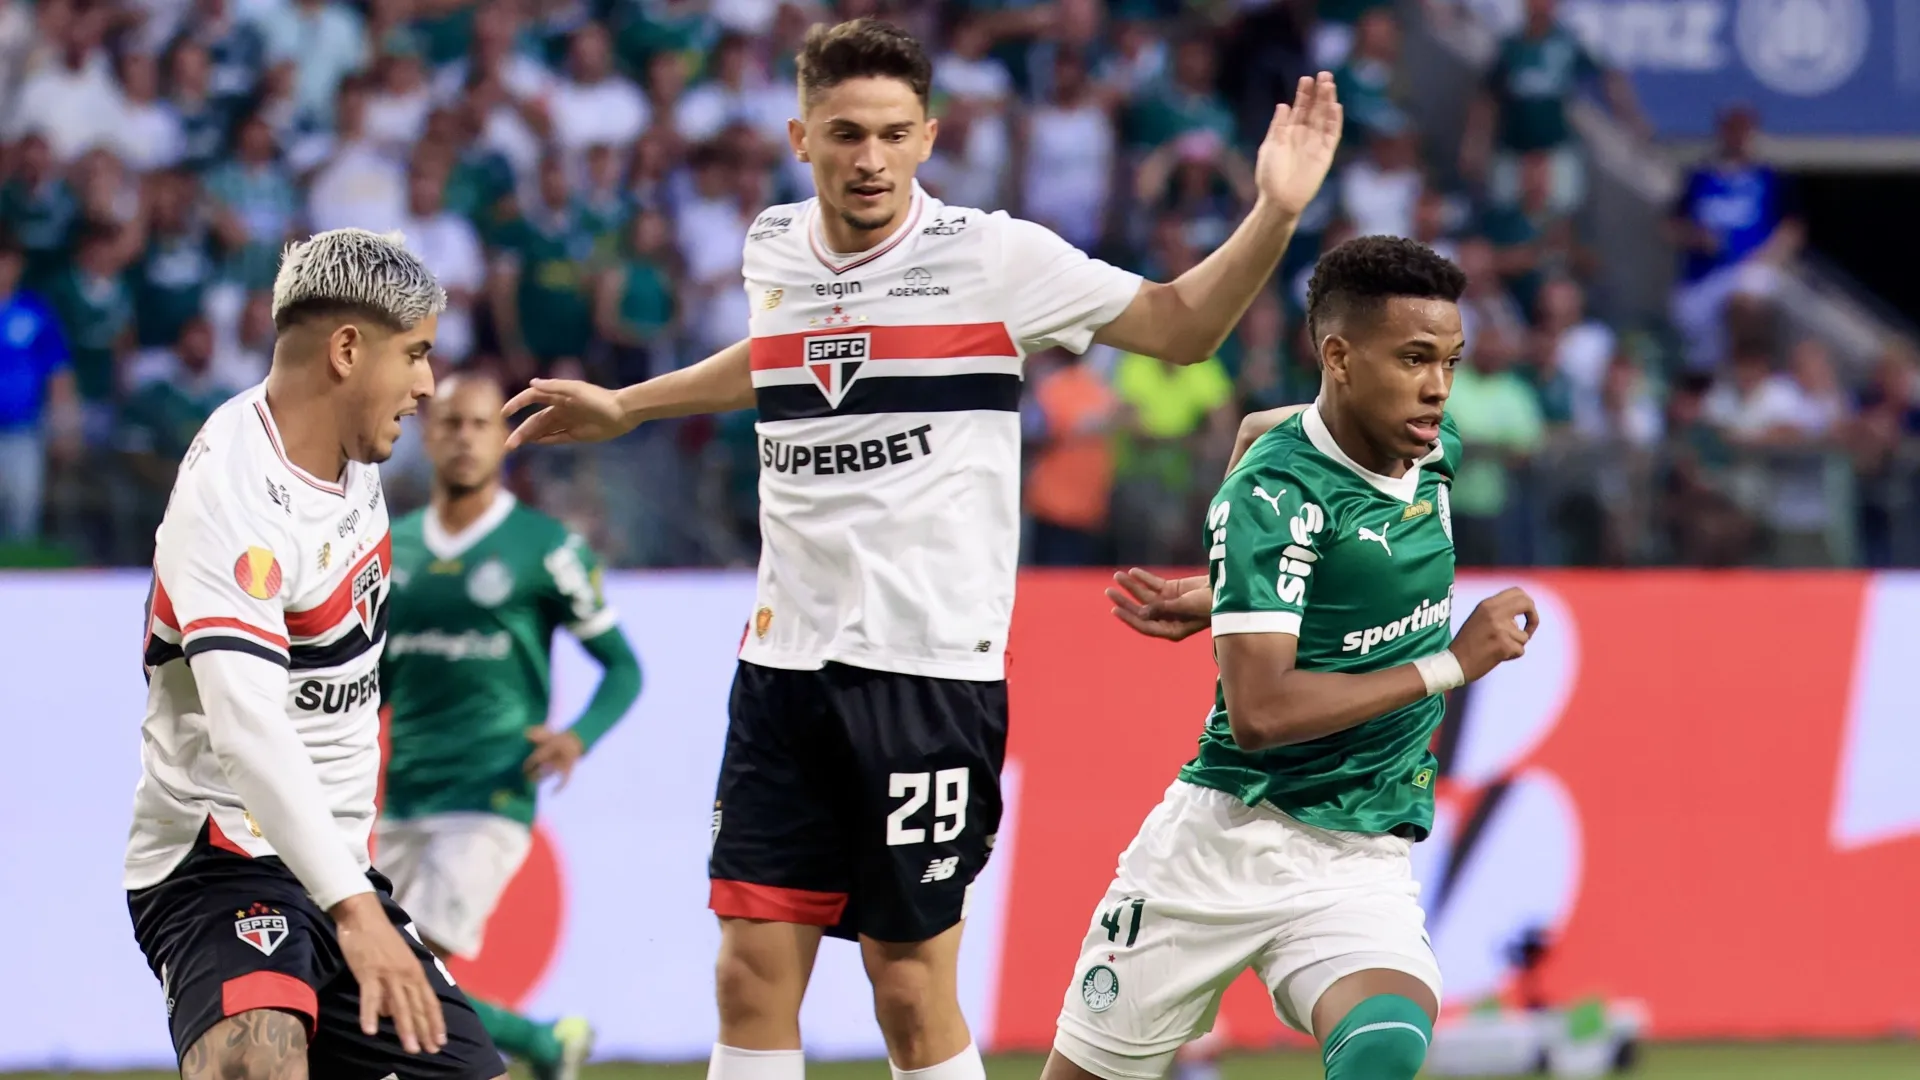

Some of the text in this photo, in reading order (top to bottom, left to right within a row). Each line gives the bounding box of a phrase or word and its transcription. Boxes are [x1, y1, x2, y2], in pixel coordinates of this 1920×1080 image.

[887, 286, 950, 297] ADEMICON
[810, 340, 864, 358] SPFC
[762, 424, 932, 475] SUPERBET
[354, 560, 381, 599] SPFC
[1342, 584, 1454, 655] sporting
[295, 662, 380, 714] SUPER
[886, 767, 969, 846] 29
[240, 916, 283, 933] SPFC
[1101, 896, 1145, 948] 41
